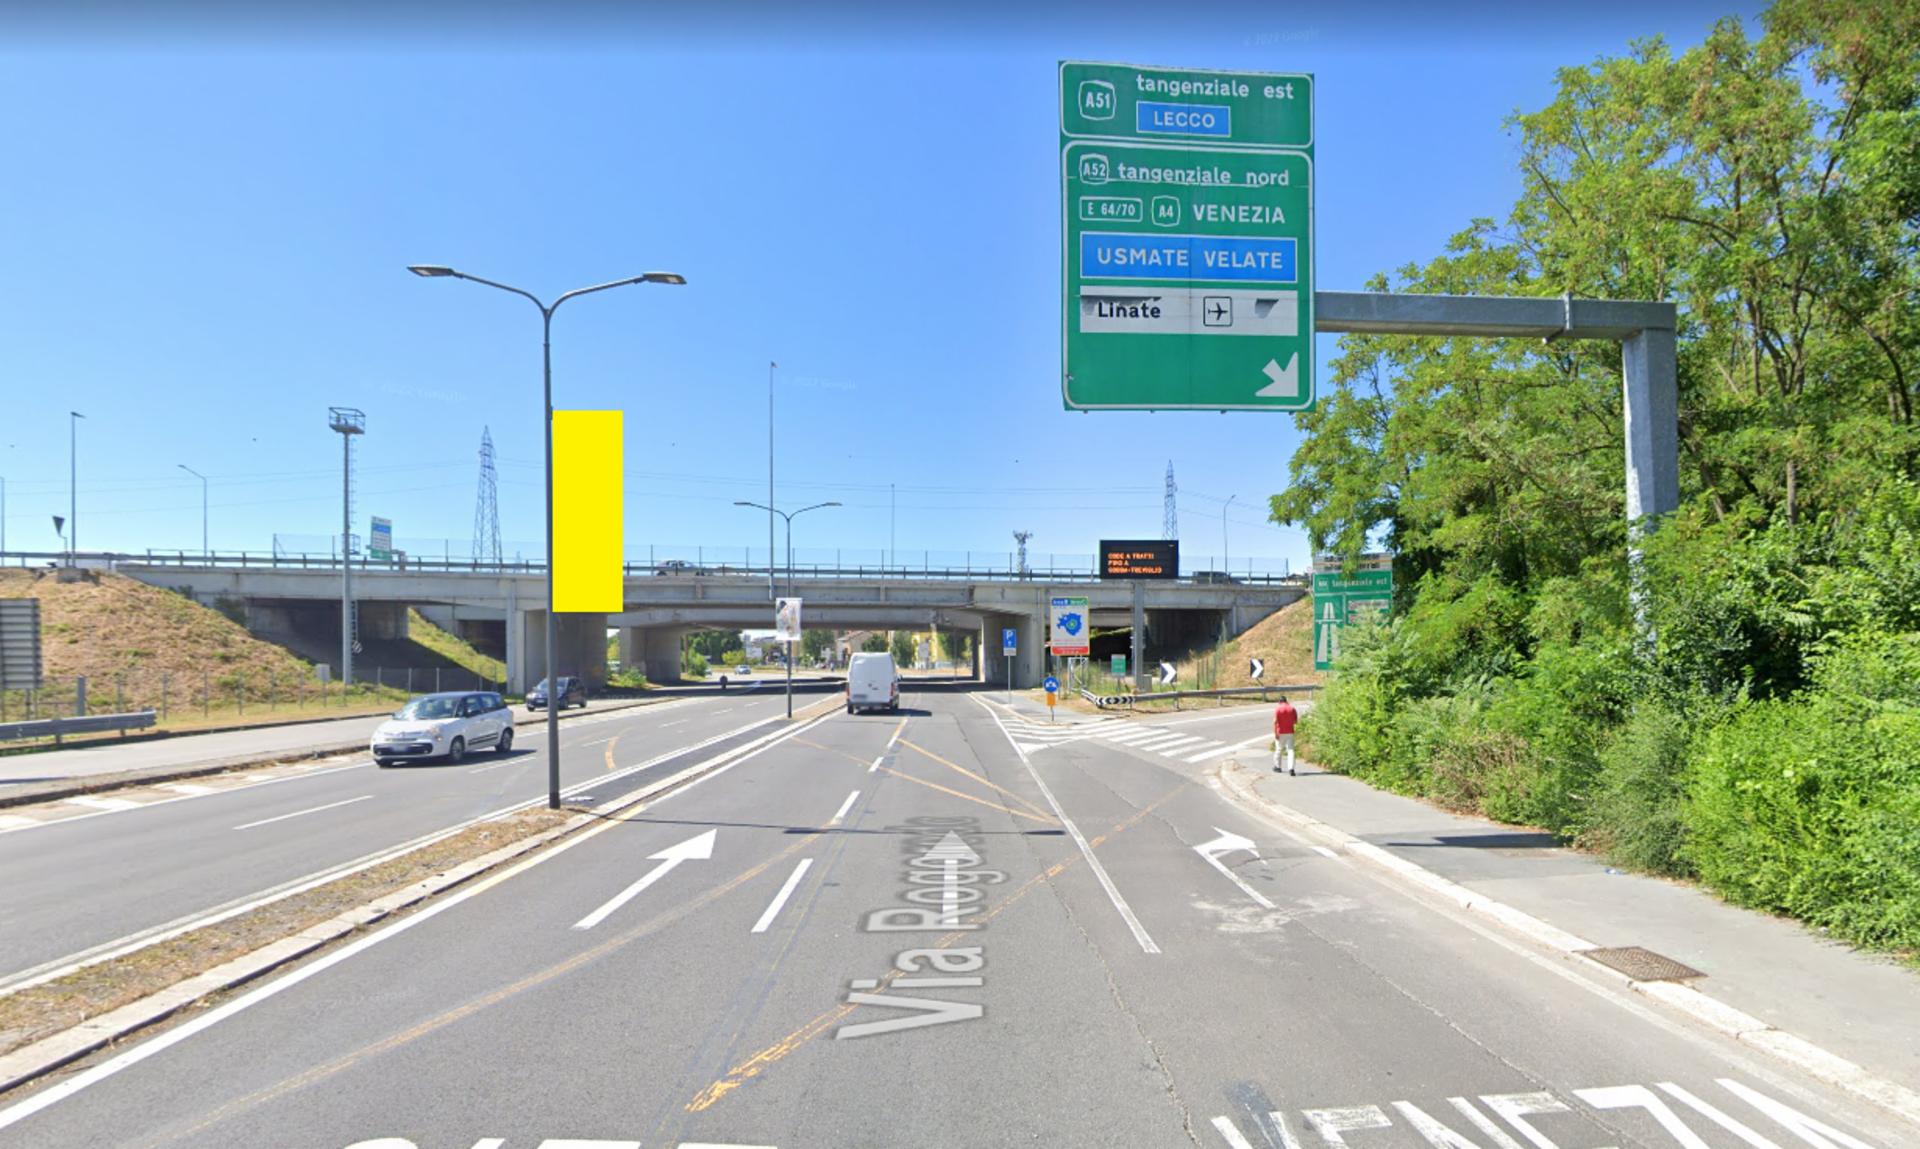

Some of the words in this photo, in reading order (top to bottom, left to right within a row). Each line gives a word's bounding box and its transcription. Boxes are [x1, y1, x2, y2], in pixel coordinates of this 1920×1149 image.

[1136, 74, 1249, 98] tangenziale
[1263, 83, 1295, 100] est
[1085, 91, 1111, 109] A51
[1153, 110, 1216, 129] LECCO
[1083, 162, 1106, 177] A52
[1117, 162, 1231, 186] tangenziale
[1246, 169, 1289, 186] nord
[1087, 202, 1094, 216] E
[1101, 203, 1136, 217] 64/70
[1159, 204, 1174, 218] A4
[1192, 204, 1285, 224] VENEZIA
[1097, 247, 1189, 267] USMATE
[1204, 250, 1283, 269] VELATE
[1097, 301, 1161, 319] Linate
